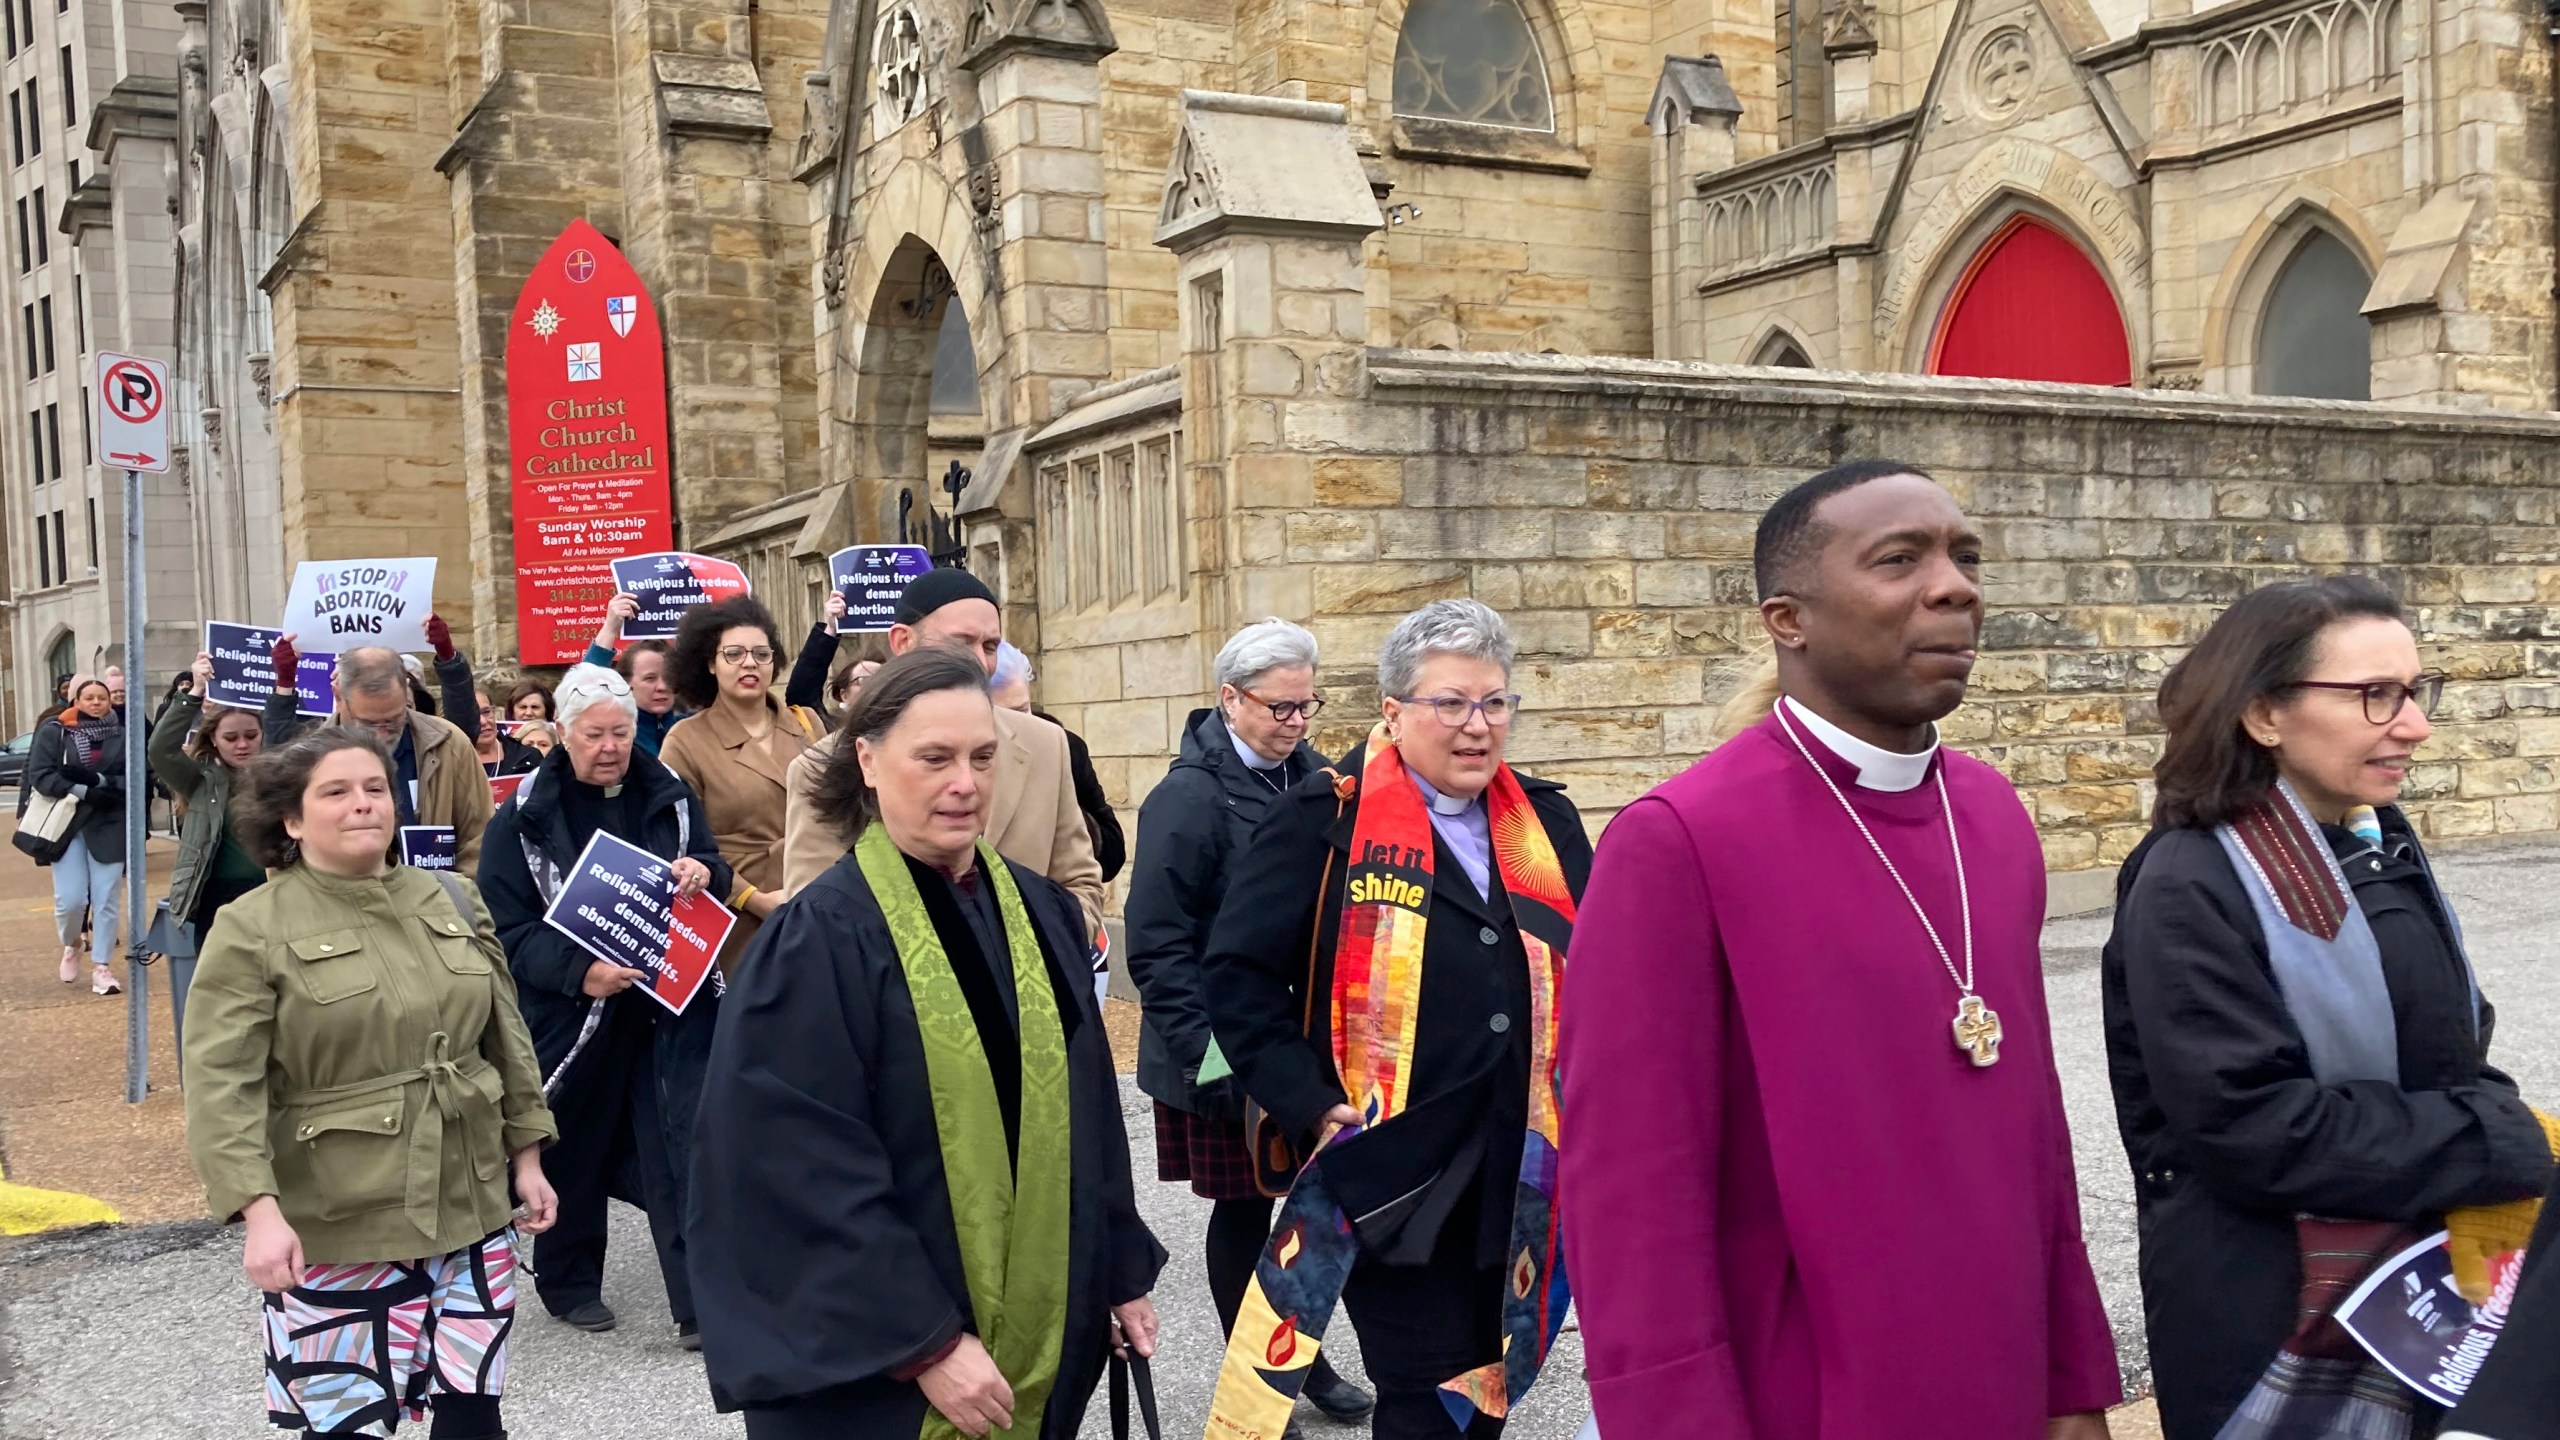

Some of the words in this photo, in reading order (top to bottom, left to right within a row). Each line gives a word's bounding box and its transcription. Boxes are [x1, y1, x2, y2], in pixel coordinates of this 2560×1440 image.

[122, 372, 152, 412] P
[546, 396, 627, 421] Christ
[540, 421, 636, 448] Church
[526, 446, 654, 476] Cathedral
[538, 483, 558, 494] Open
[558, 482, 572, 492] For
[572, 481, 596, 492] Prayer
[598, 480, 604, 488] &
[606, 478, 644, 488] Meditation
[548, 494, 565, 503] Mon.
[571, 493, 592, 502] Thurs.
[596, 492, 612, 500] 9am
[618, 490, 632, 500] 4pm
[558, 504, 579, 513] Friday
[583, 502, 598, 511] 9am
[604, 502, 624, 511] 12pm
[538, 520, 588, 534] Sunday
[590, 516, 646, 530] Worship
[542, 534, 570, 546] 8am
[574, 533, 584, 544] &
[588, 530, 642, 542] 10:30am
[562, 548, 572, 557] All
[574, 546, 588, 556] Are
[590, 545, 625, 556] Welcome
[339, 567, 388, 586] STOP
[518, 568, 532, 576] The
[532, 567, 547, 576] Very
[548, 566, 562, 574] Rev.
[564, 564, 585, 573] Kathie
[534, 576, 614, 588] www.christchurchca
[627, 577, 685, 592] Religious
[688, 576, 740, 588] freedom
[839, 572, 890, 586] Religious
[894, 572, 918, 584] free
[550, 586, 618, 602] 314-231-3
[658, 593, 712, 606] demands
[866, 588, 902, 600] deman
[314, 590, 406, 619] ABORTION
[531, 608, 545, 616] The
[546, 606, 564, 616] Right
[564, 606, 580, 614] Rev.
[580, 605, 599, 613] Deon
[847, 603, 894, 616] abortion
[330, 614, 382, 634] BANS
[556, 615, 606, 626] www.dioces
[552, 628, 598, 643] 314-23
[216, 647, 272, 665] Religious
[556, 650, 580, 659] Parish
[220, 678, 274, 694] abortion
[414, 854, 453, 870] Religious
[1362, 839, 1399, 867] let
[1404, 846, 1426, 869] it
[1350, 872, 1425, 908] shine
[588, 862, 661, 912] Religious
[660, 906, 708, 952] freedom
[614, 902, 674, 950] demands
[576, 903, 640, 952] abortion
[638, 946, 680, 983] rights.
[2428, 1328, 2498, 1396] Religious
[2472, 1249, 2526, 1330] freedo
